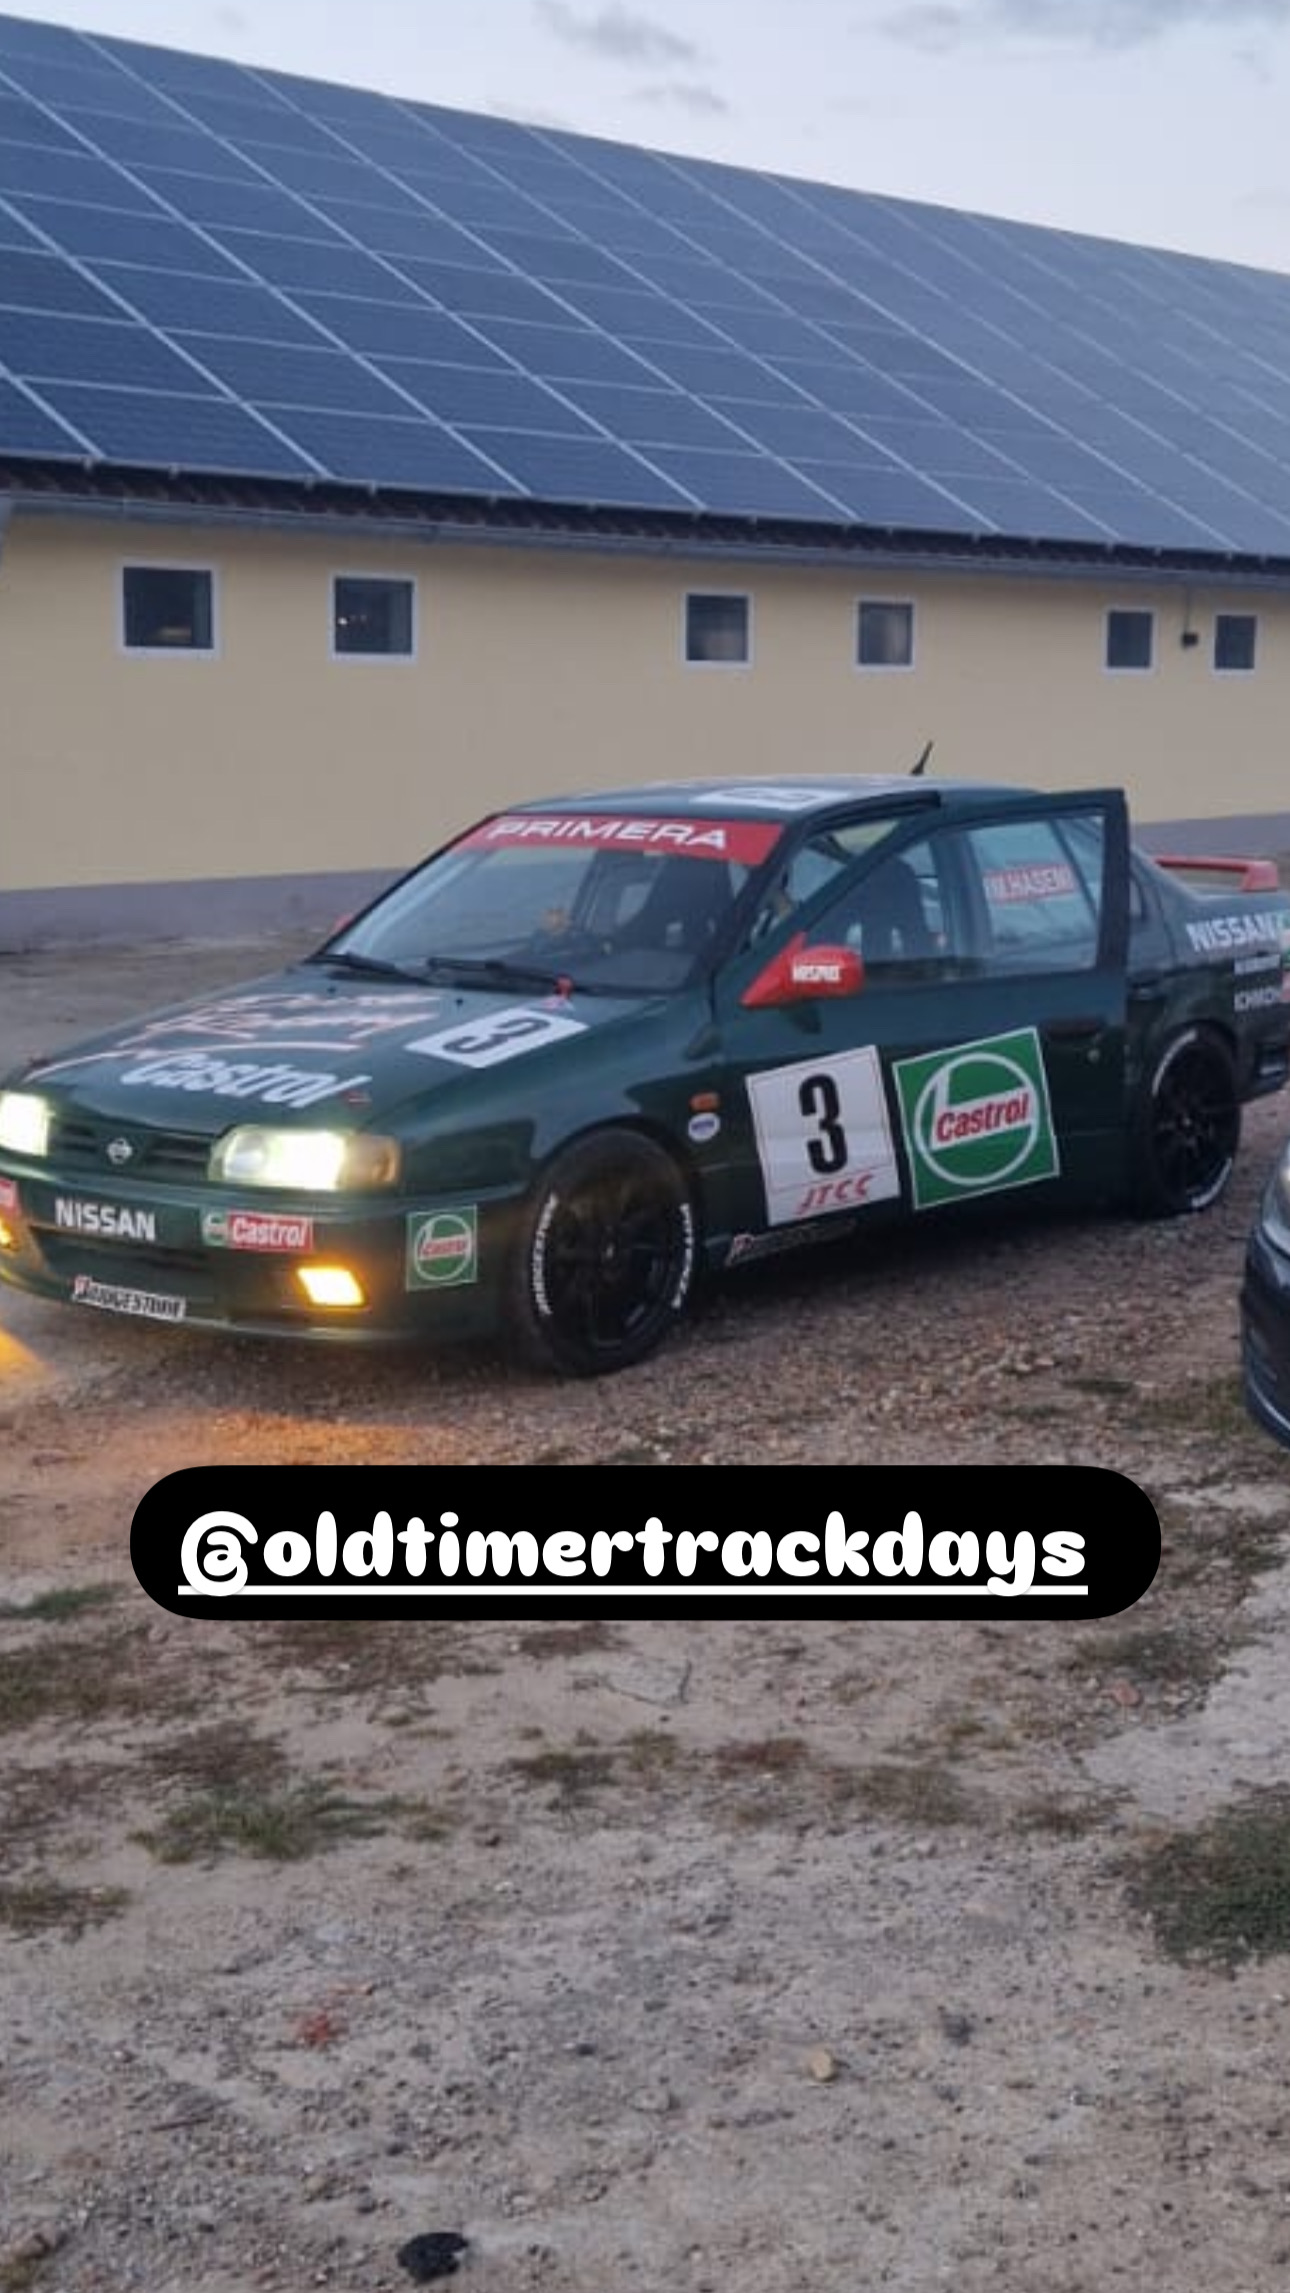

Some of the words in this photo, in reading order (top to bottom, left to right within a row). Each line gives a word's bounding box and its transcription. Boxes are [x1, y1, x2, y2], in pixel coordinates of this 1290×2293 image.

[486, 818, 727, 850] PRIMERA
[1185, 911, 1276, 953] NISSAN
[442, 1018, 551, 1054] 3
[119, 1053, 373, 1108] Castrol
[799, 1073, 849, 1175] 3
[934, 1092, 1030, 1142] Castrol
[795, 1174, 874, 1216] JTCC
[54, 1198, 156, 1241] NISSAN
[231, 1217, 309, 1248] Castrol
